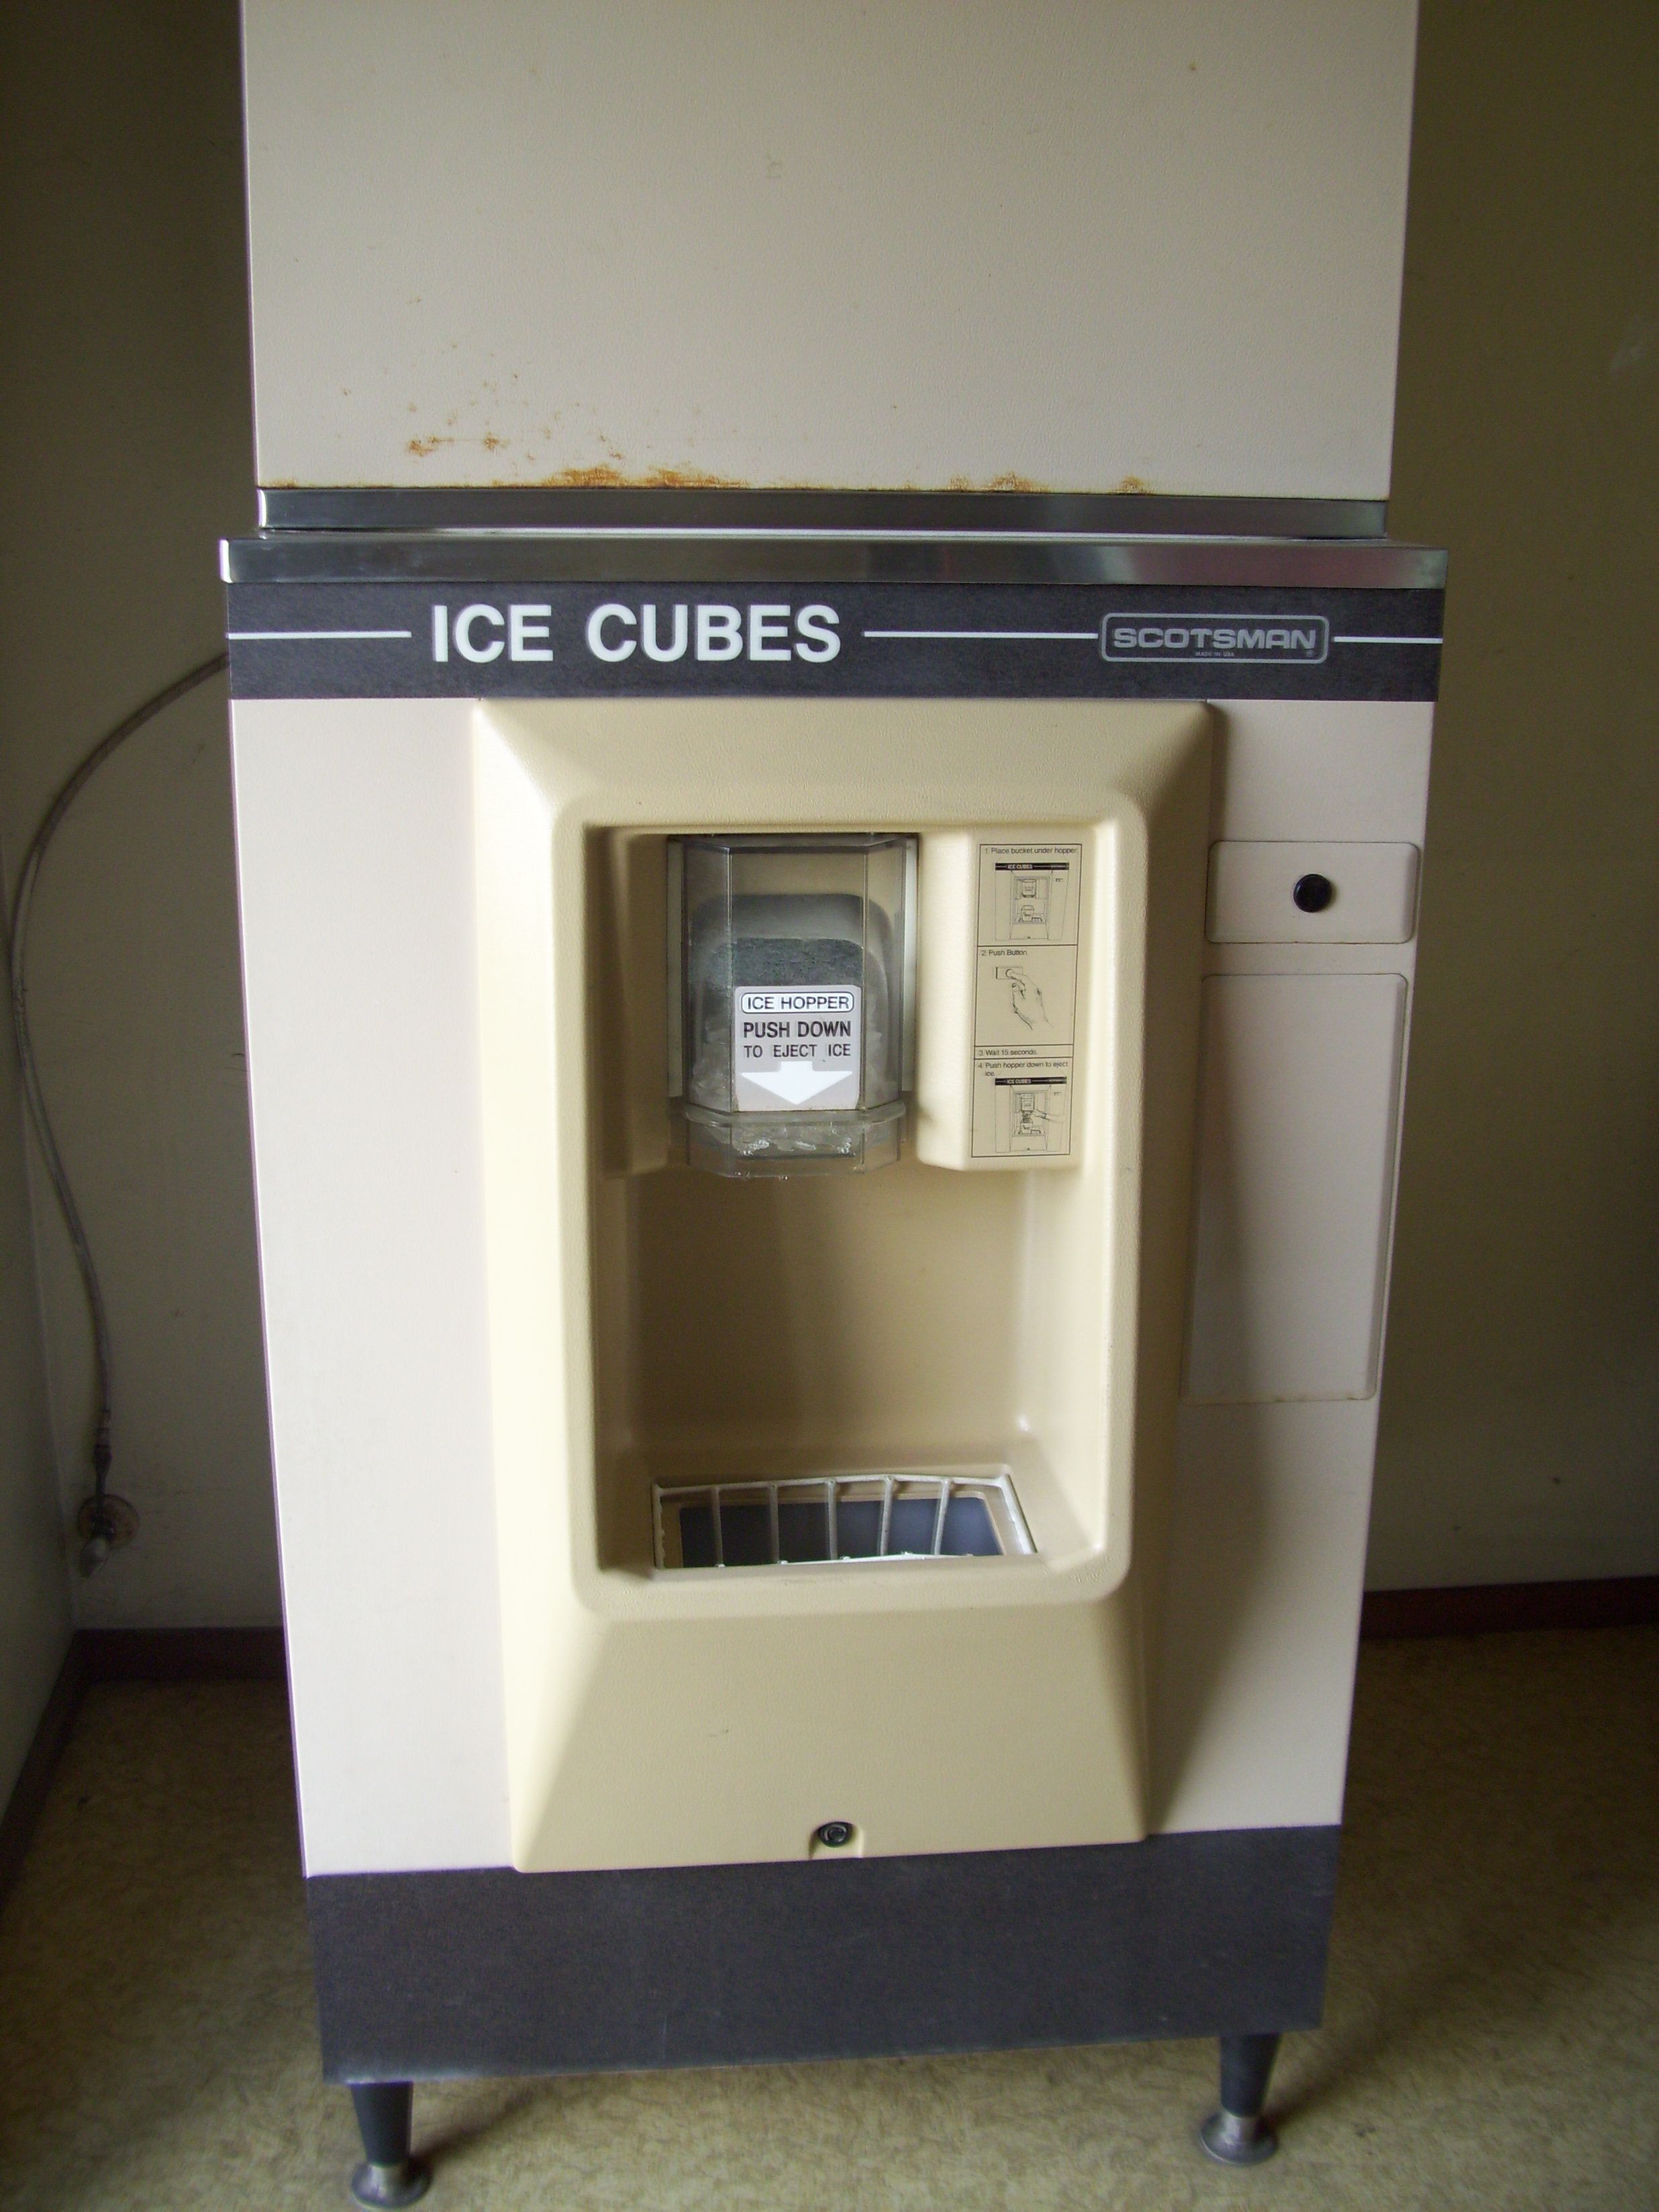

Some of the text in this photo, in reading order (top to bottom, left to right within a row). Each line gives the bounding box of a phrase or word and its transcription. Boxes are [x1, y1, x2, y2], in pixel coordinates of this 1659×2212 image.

[433, 603, 841, 663] ICE CUBES
[1114, 627, 1316, 650] SCOTSMAN
[747, 996, 850, 1010] ICE HOPPER
[743, 1020, 851, 1038] PUSH DOWN
[743, 1043, 851, 1058] TO EJECT ICE
[1053, 1060, 1068, 1069] eject
